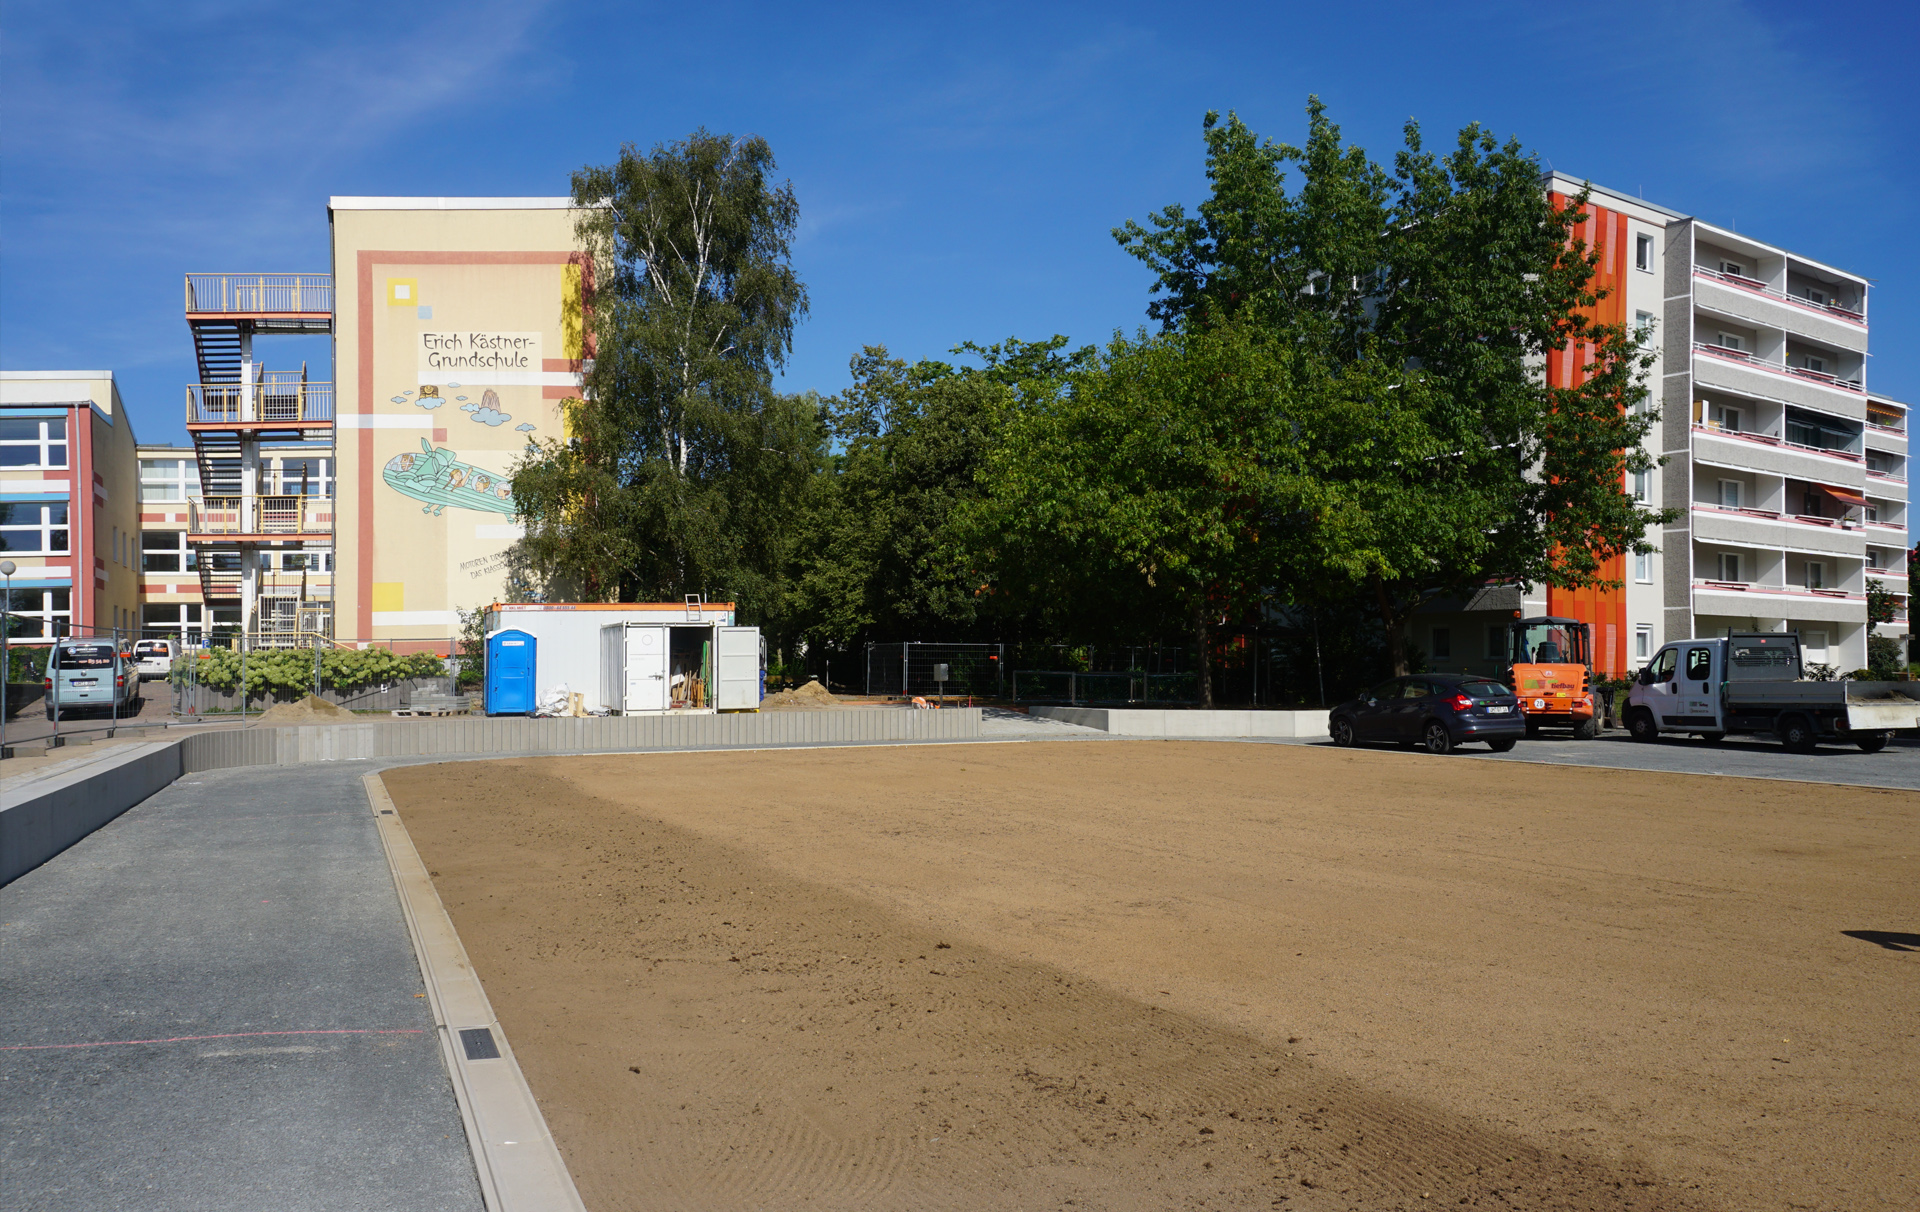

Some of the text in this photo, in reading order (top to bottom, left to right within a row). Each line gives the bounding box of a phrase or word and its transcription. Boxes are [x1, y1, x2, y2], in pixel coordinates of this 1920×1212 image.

[423, 333, 536, 351] Erich Kästner-
[428, 351, 529, 370] Grundschule
[459, 556, 489, 572] MOTOREN
[470, 569, 482, 580] DAS
